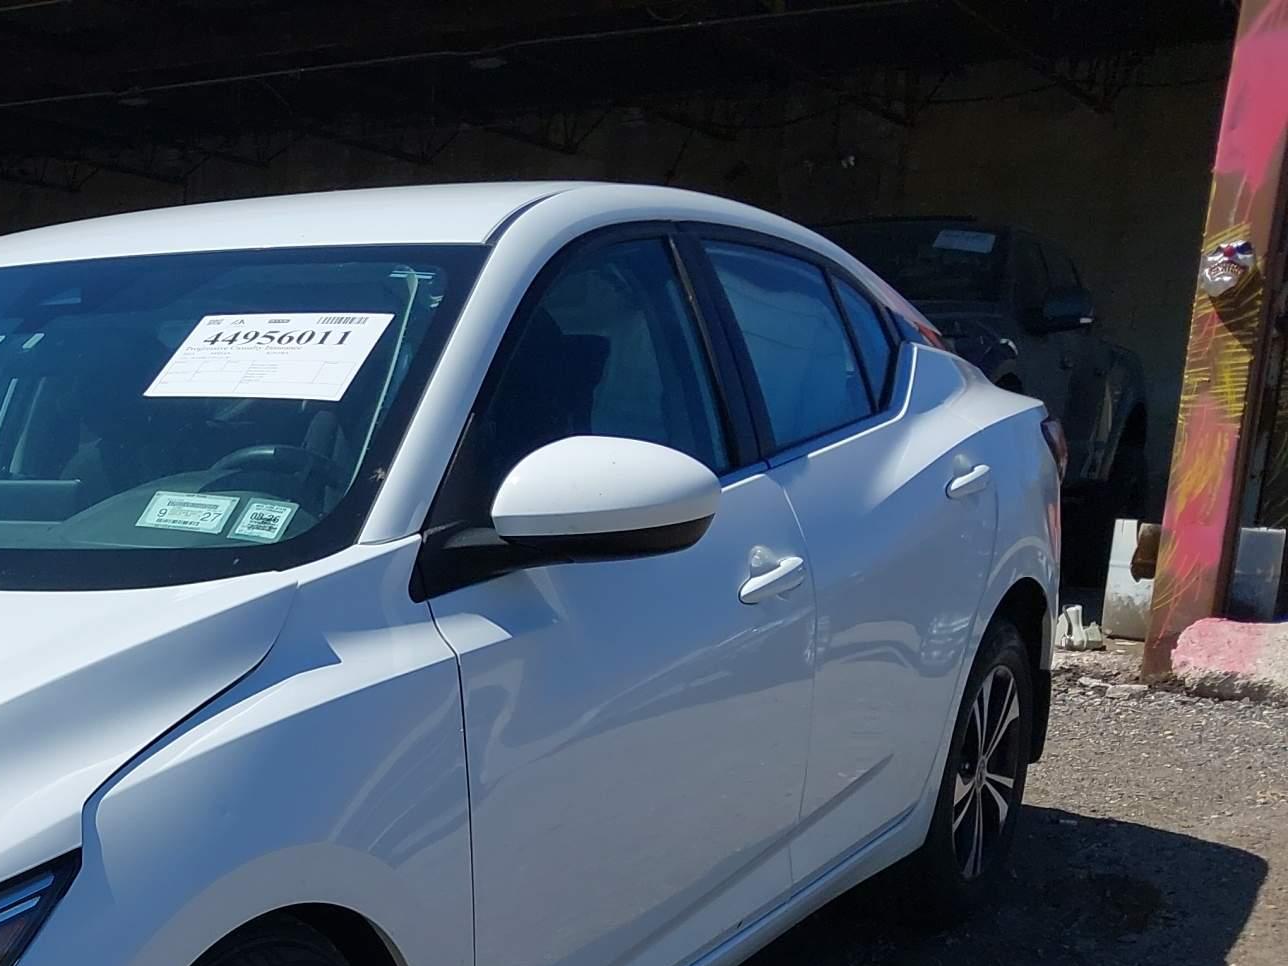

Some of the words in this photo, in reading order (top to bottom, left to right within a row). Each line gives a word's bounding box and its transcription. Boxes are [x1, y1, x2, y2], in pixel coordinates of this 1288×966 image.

[203, 329, 353, 346] 44956011
[157, 508, 168, 518] 9
[200, 511, 222, 523] 27
